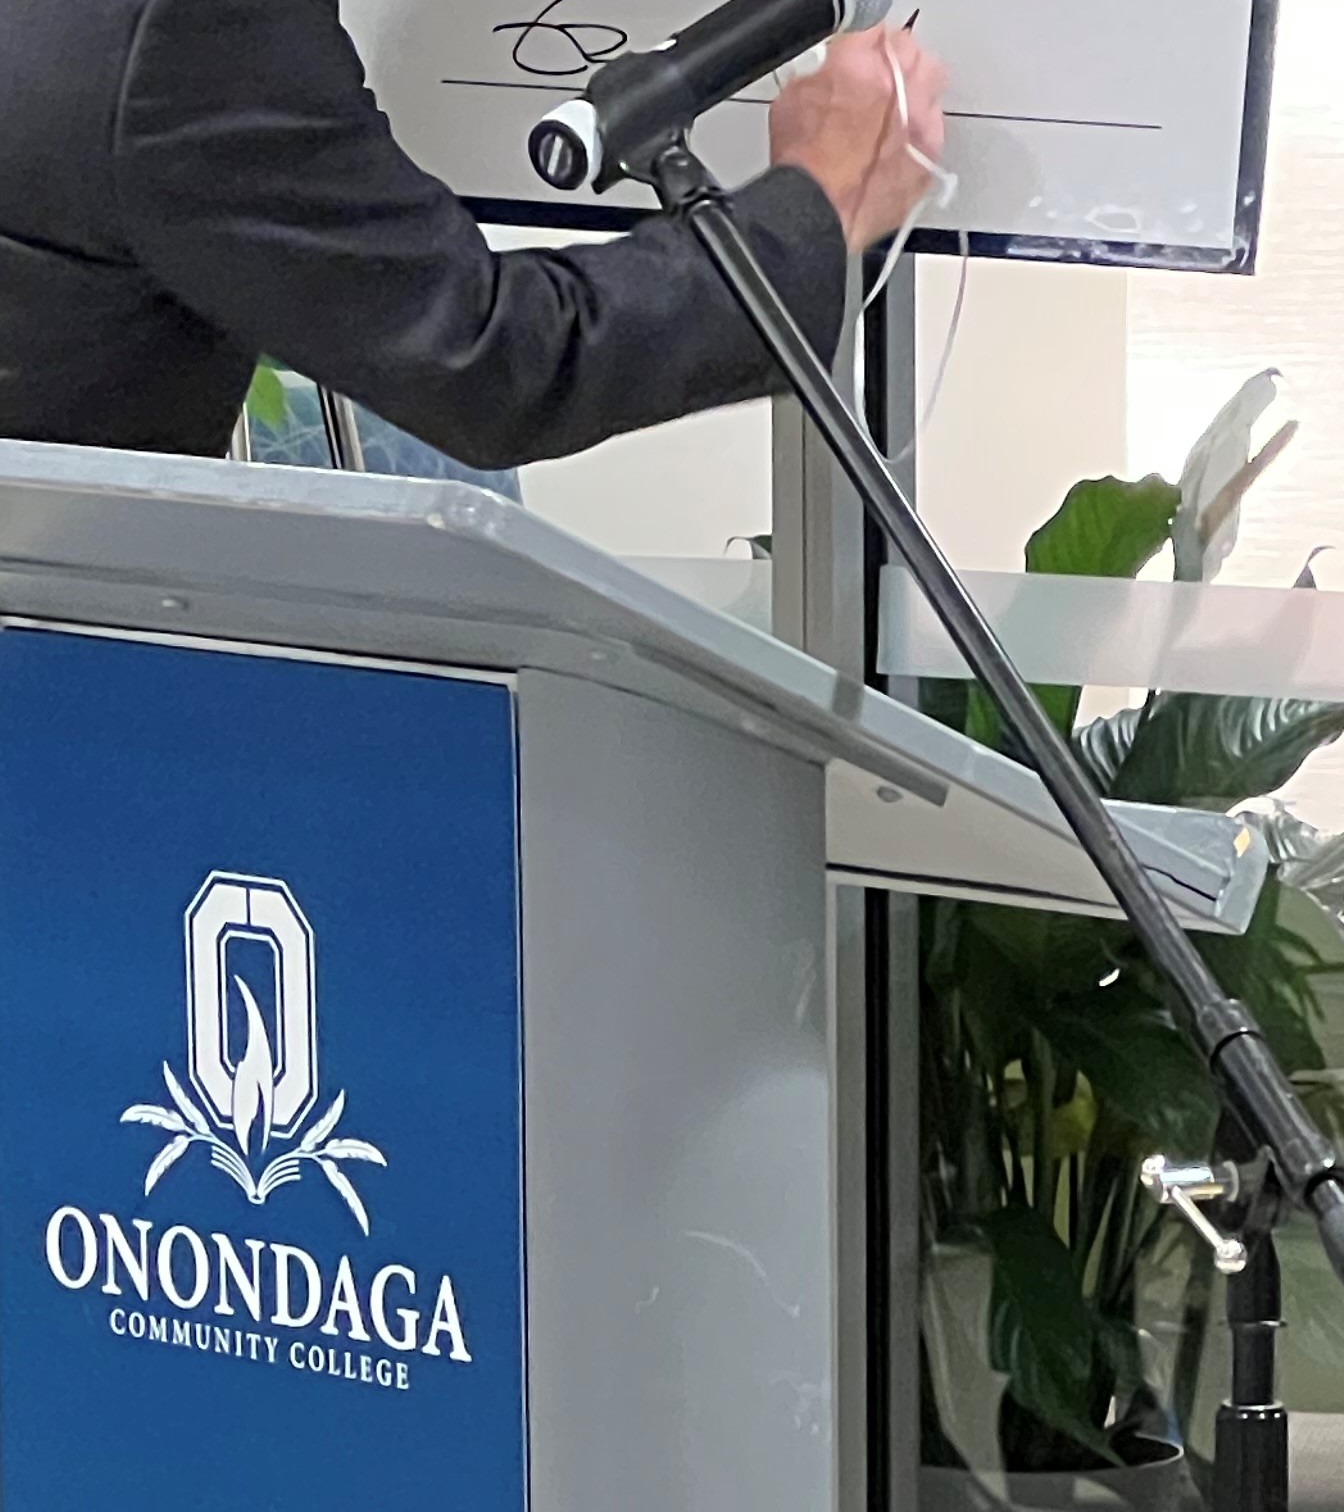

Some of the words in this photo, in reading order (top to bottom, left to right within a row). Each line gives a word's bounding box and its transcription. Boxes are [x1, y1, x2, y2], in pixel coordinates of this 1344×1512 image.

[45, 1205, 473, 1364] ONONDAGA
[109, 1307, 279, 1365] COMMUNITY
[289, 1341, 411, 1391] COLLEGE
